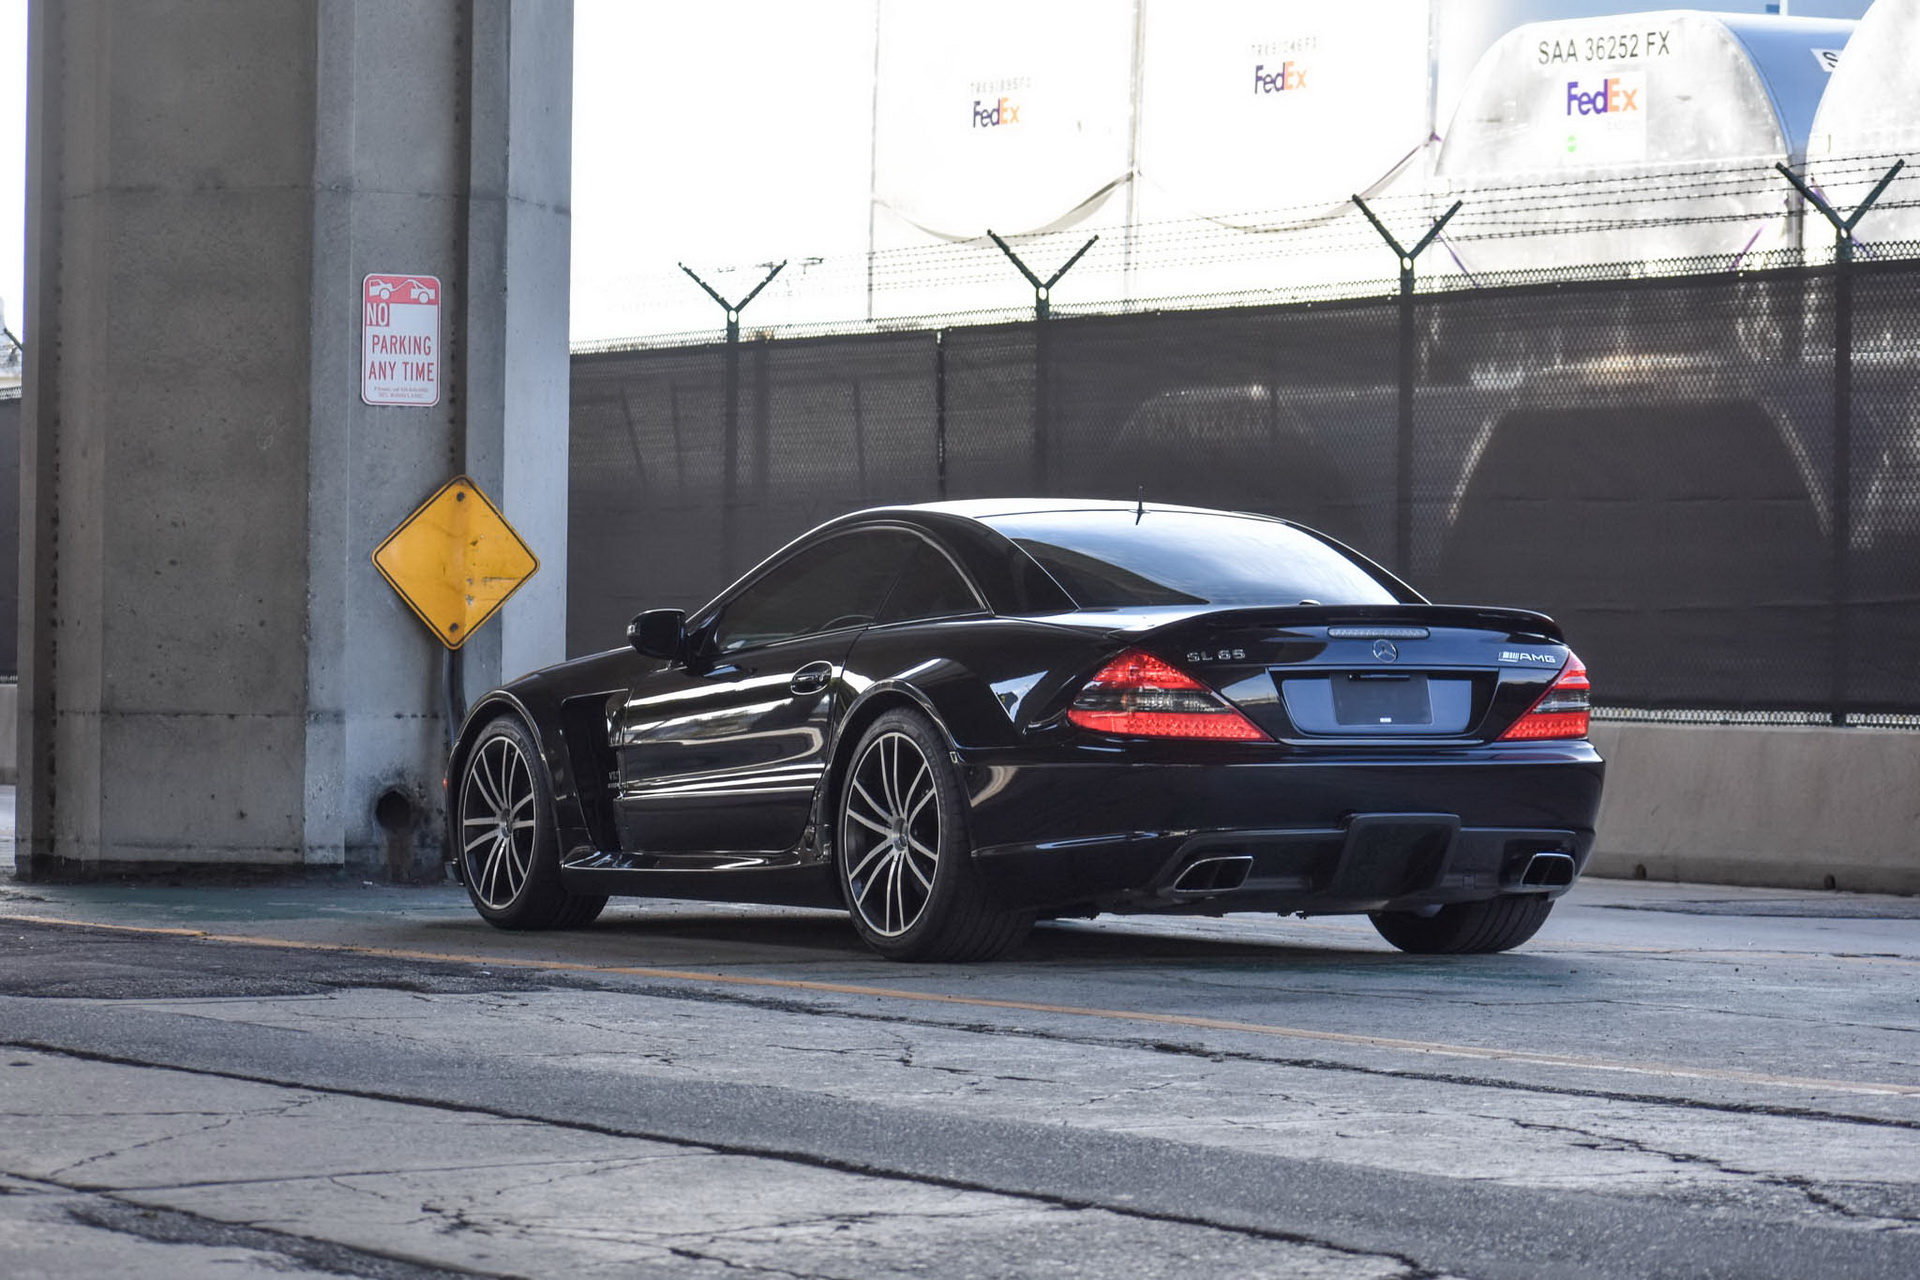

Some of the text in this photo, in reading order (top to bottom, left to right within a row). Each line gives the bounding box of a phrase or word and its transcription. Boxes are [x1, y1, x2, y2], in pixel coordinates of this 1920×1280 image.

[1538, 30, 1670, 65] SAA 36252 FX
[1254, 61, 1308, 95] FedEx
[1567, 78, 1638, 116] FedEx
[972, 97, 1020, 129] FedEx
[367, 302, 388, 326] NO
[372, 334, 431, 355] PARKING
[368, 361, 434, 381] ANY TIME
[1187, 649, 1246, 662] SL 65
[1519, 652, 1556, 663] AMG
